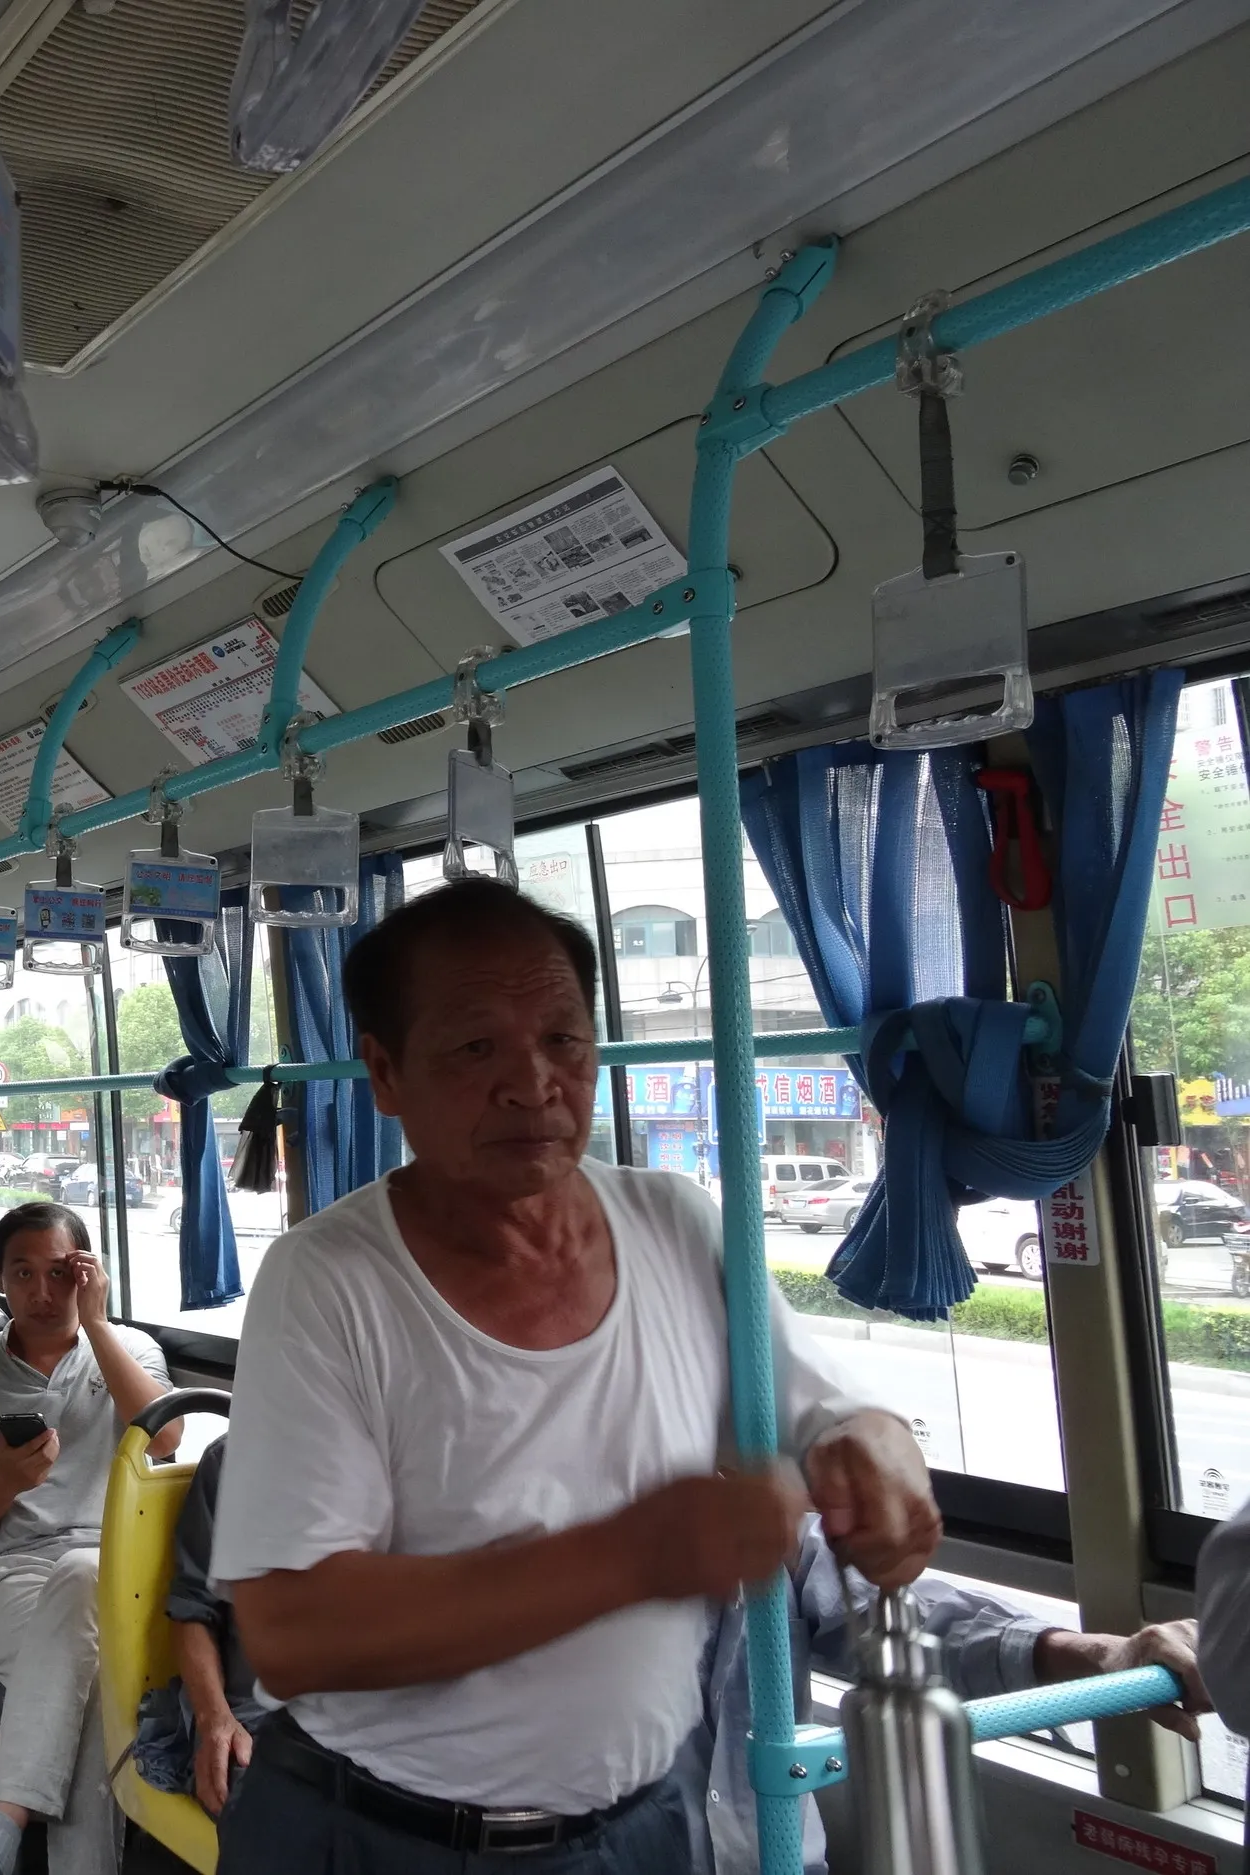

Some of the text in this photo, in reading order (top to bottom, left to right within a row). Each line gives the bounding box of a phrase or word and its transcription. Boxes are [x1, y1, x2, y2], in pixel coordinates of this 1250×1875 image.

[1194, 735, 1235, 756] 警告
[529, 859, 567, 878] 应急出口
[1157, 759, 1198, 929] 全出口
[1050, 1182, 1089, 1261] 乱动谢谢
